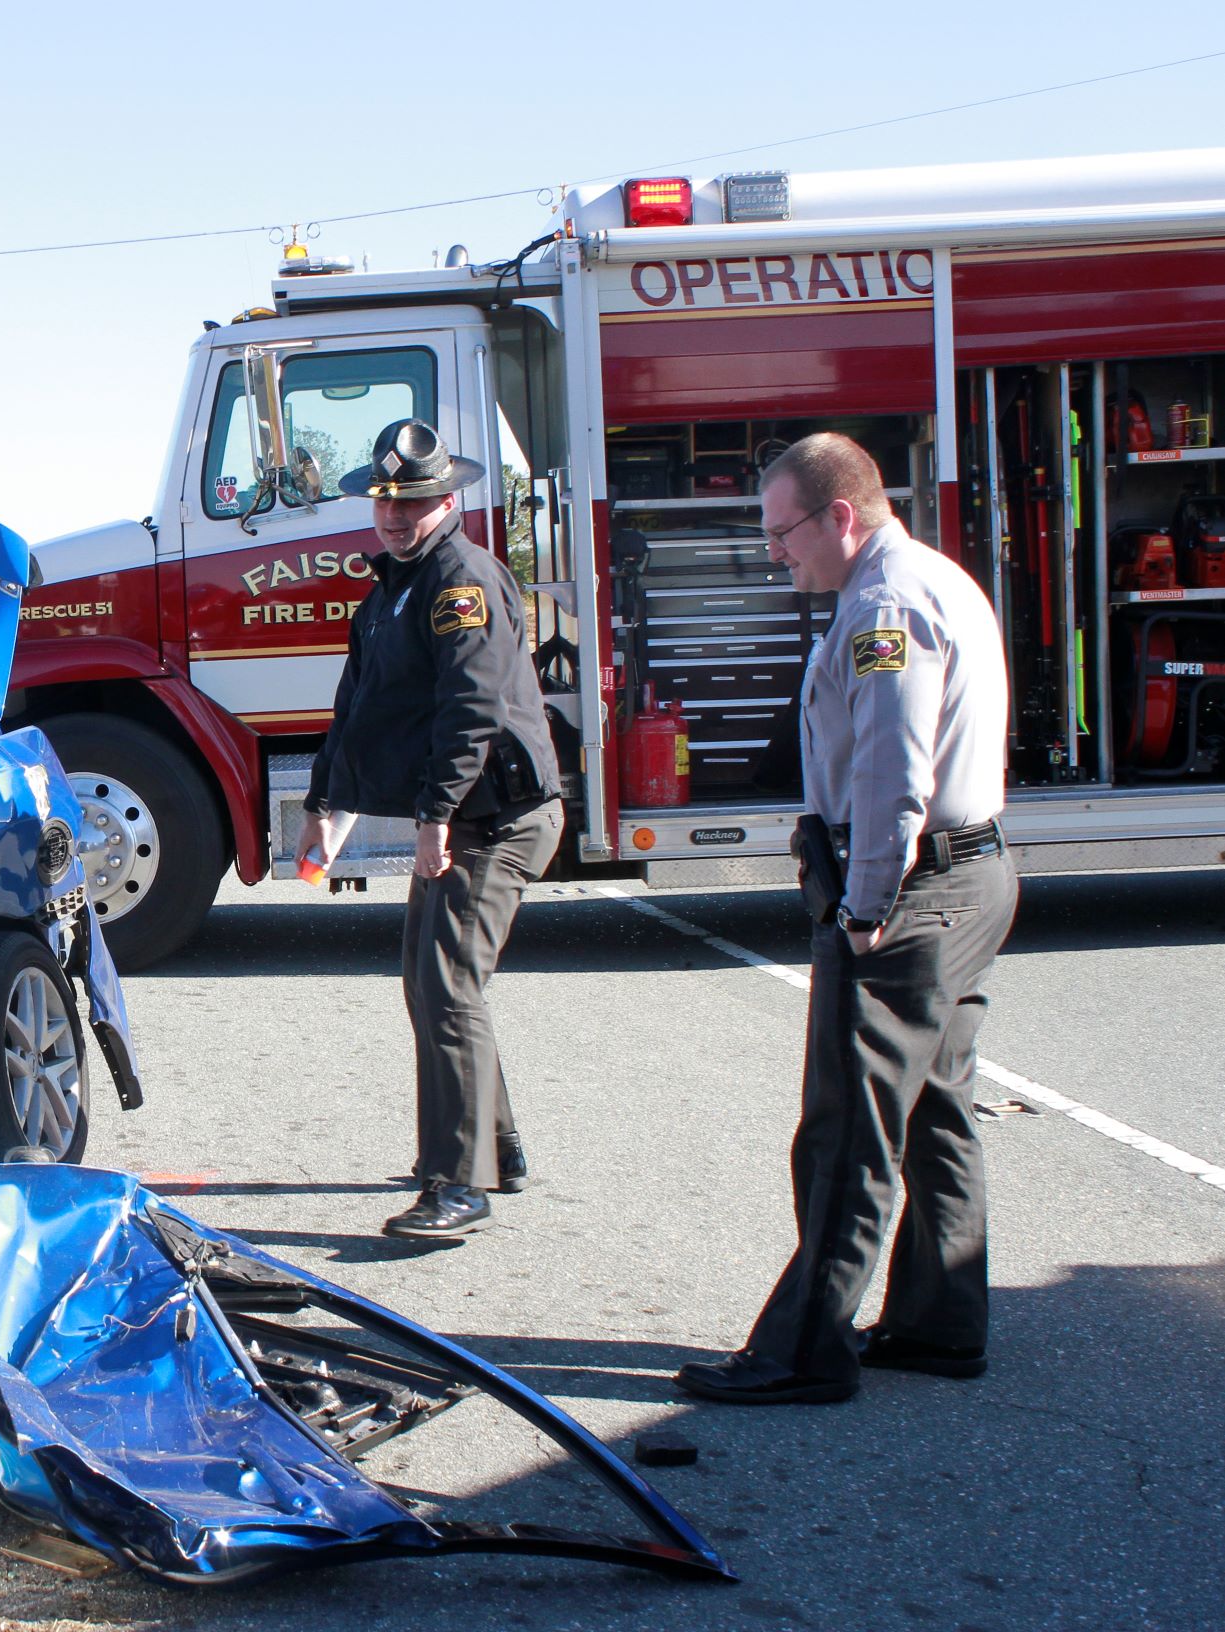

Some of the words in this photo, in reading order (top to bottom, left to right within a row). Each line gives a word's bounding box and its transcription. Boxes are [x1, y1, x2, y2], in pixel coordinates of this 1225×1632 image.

[630, 248, 934, 307] OPERATIO
[1142, 452, 1177, 460] CHAINSAW
[216, 477, 237, 486] AED
[242, 551, 379, 597] FAISO
[1142, 591, 1182, 599] VENTMASTER
[19, 603, 92, 620] RESCUE
[94, 601, 113, 615] 51
[243, 602, 315, 625] FIRE
[696, 830, 740, 840] Hackney
